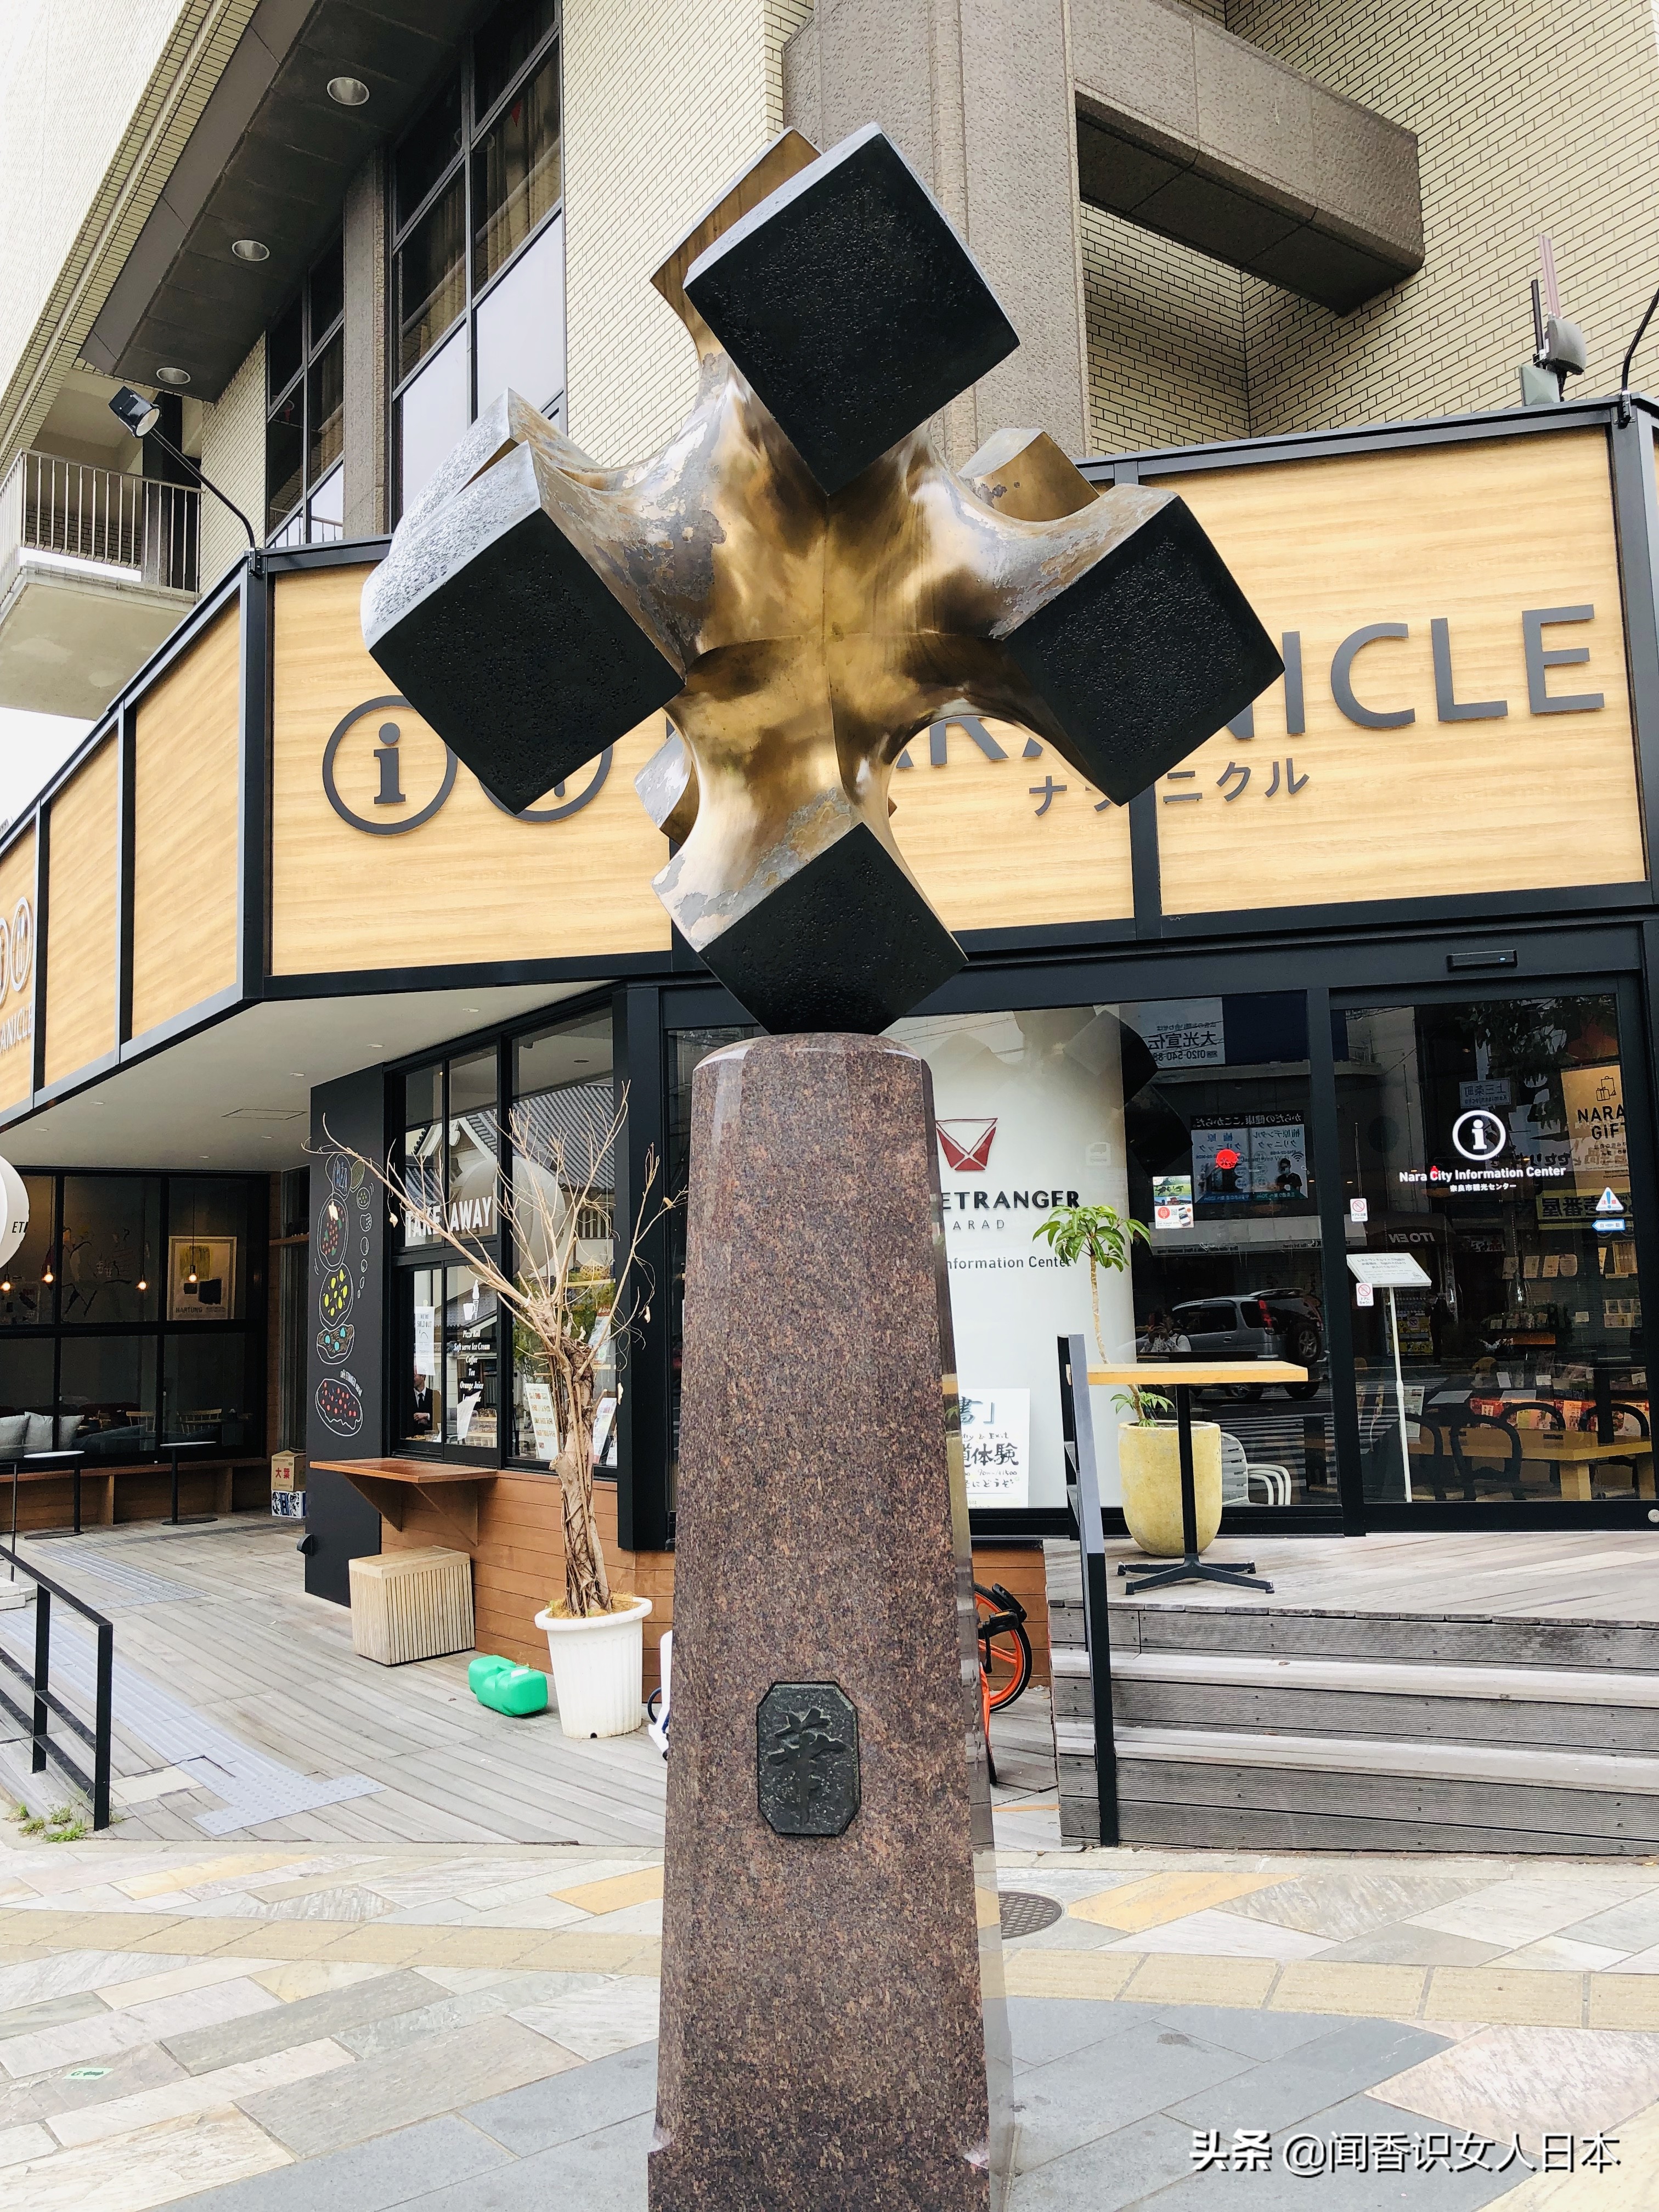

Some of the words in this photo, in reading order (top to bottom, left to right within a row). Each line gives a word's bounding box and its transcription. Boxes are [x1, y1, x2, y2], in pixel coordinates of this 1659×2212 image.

[1029, 757, 1310, 817] ナニクル
[1577, 1104, 1625, 1124] NARA
[1399, 1171, 1427, 1182] Nara
[1430, 1170, 1452, 1182] City
[1455, 1167, 1523, 1180] Information
[1526, 1166, 1566, 1177] Center
[1449, 1183, 1517, 1192] 奈良市観光センター
[450, 1196, 492, 1232] AWAY
[953, 1219, 1005, 1230] ARAD
[947, 1256, 1024, 1269] nformation
[1029, 1256, 1073, 1267] Center
[466, 1355, 478, 1365] Coffee
[460, 1381, 473, 1391] Orange
[473, 1381, 484, 1389] Juice
